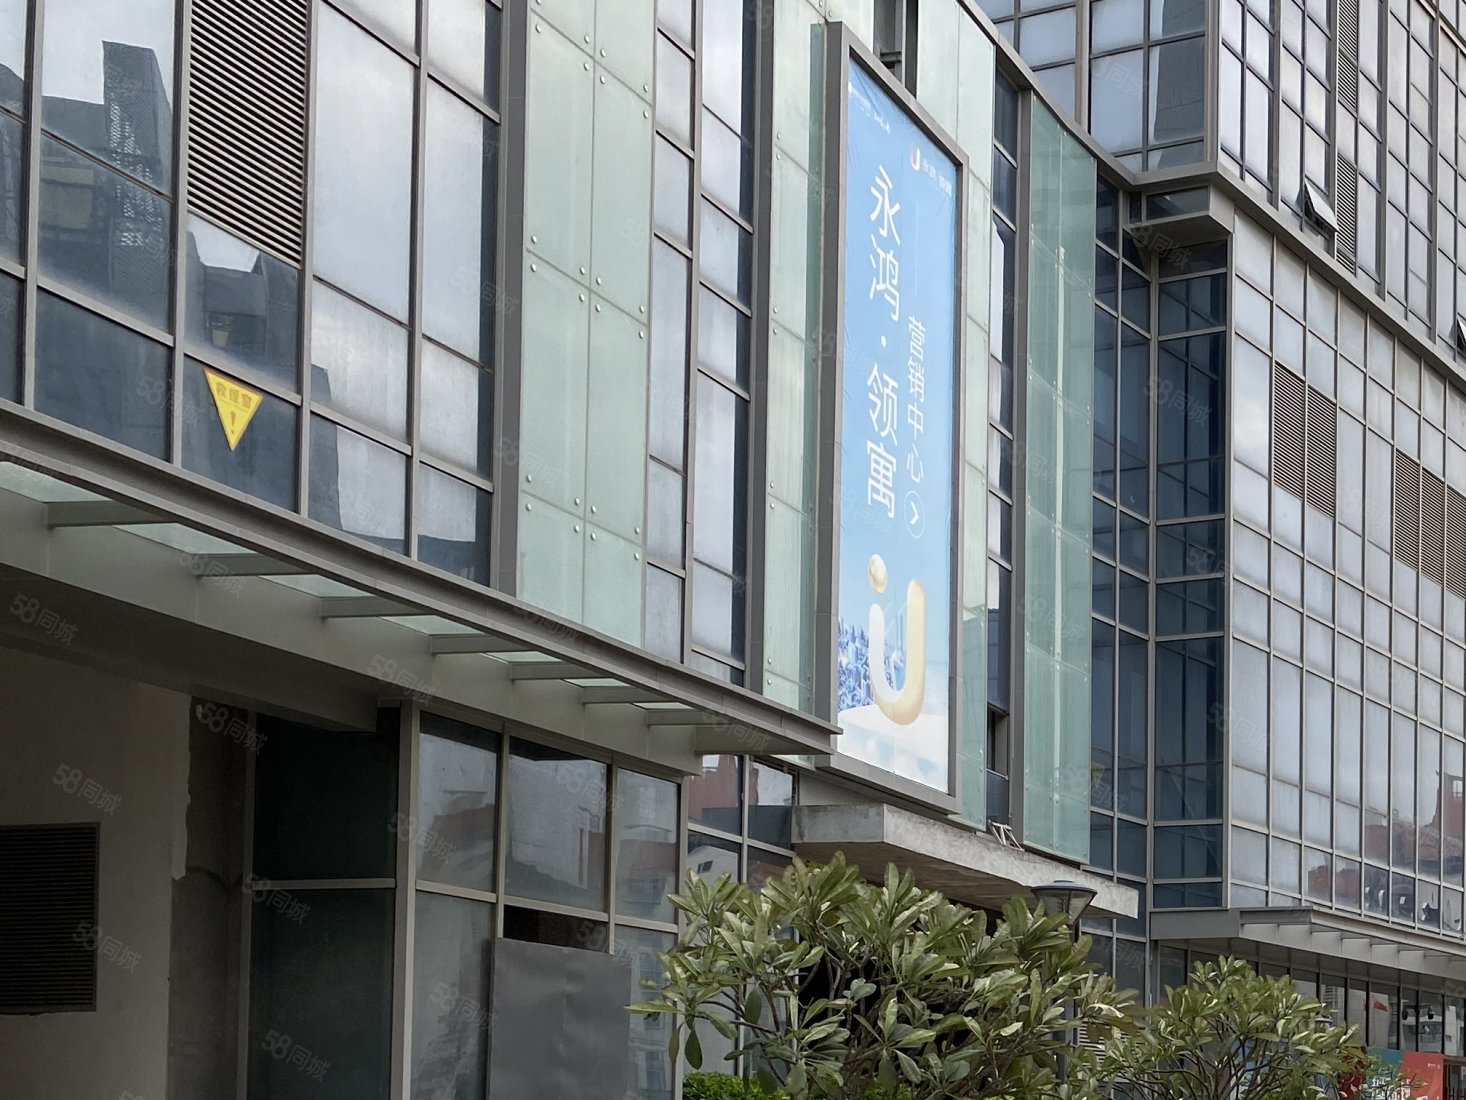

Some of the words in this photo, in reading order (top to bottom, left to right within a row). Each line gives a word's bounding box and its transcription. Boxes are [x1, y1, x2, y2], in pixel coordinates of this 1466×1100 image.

[866, 164, 901, 519] 永鸿·领寓
[906, 315, 926, 484] 营销中心
